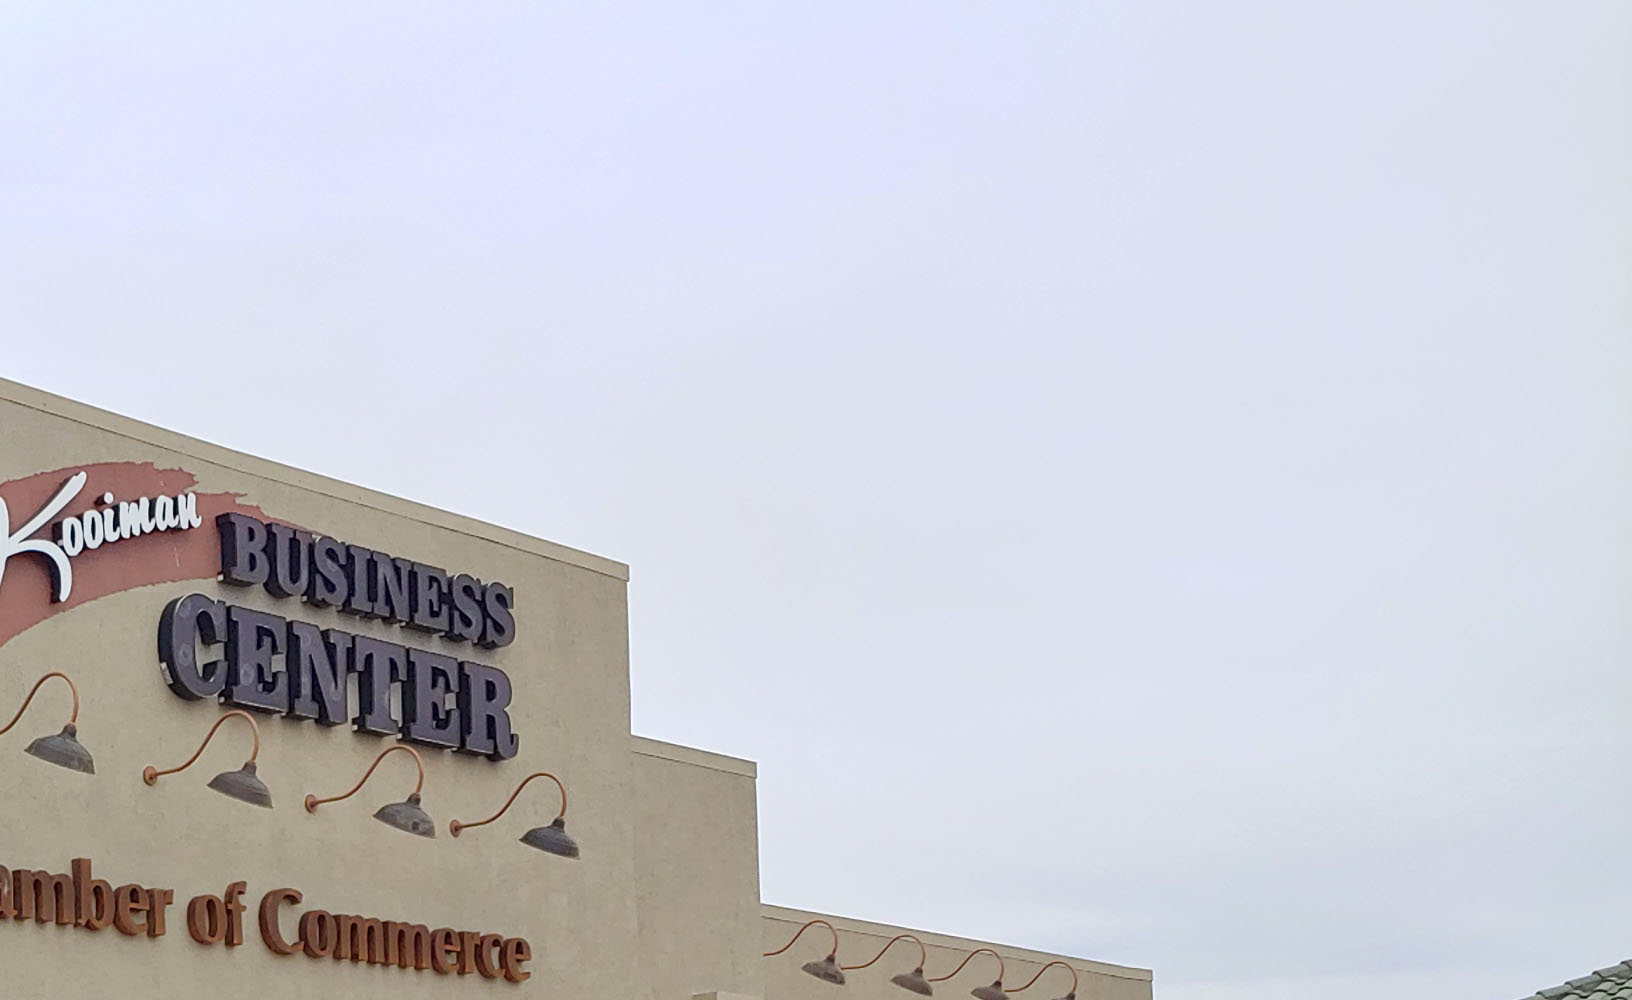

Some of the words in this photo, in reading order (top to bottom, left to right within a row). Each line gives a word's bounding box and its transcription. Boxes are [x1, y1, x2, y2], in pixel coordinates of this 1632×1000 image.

[216, 511, 515, 648] BUSINESS
[158, 593, 518, 760] CENTER
[187, 881, 247, 946] of
[259, 887, 531, 982] Commerce
